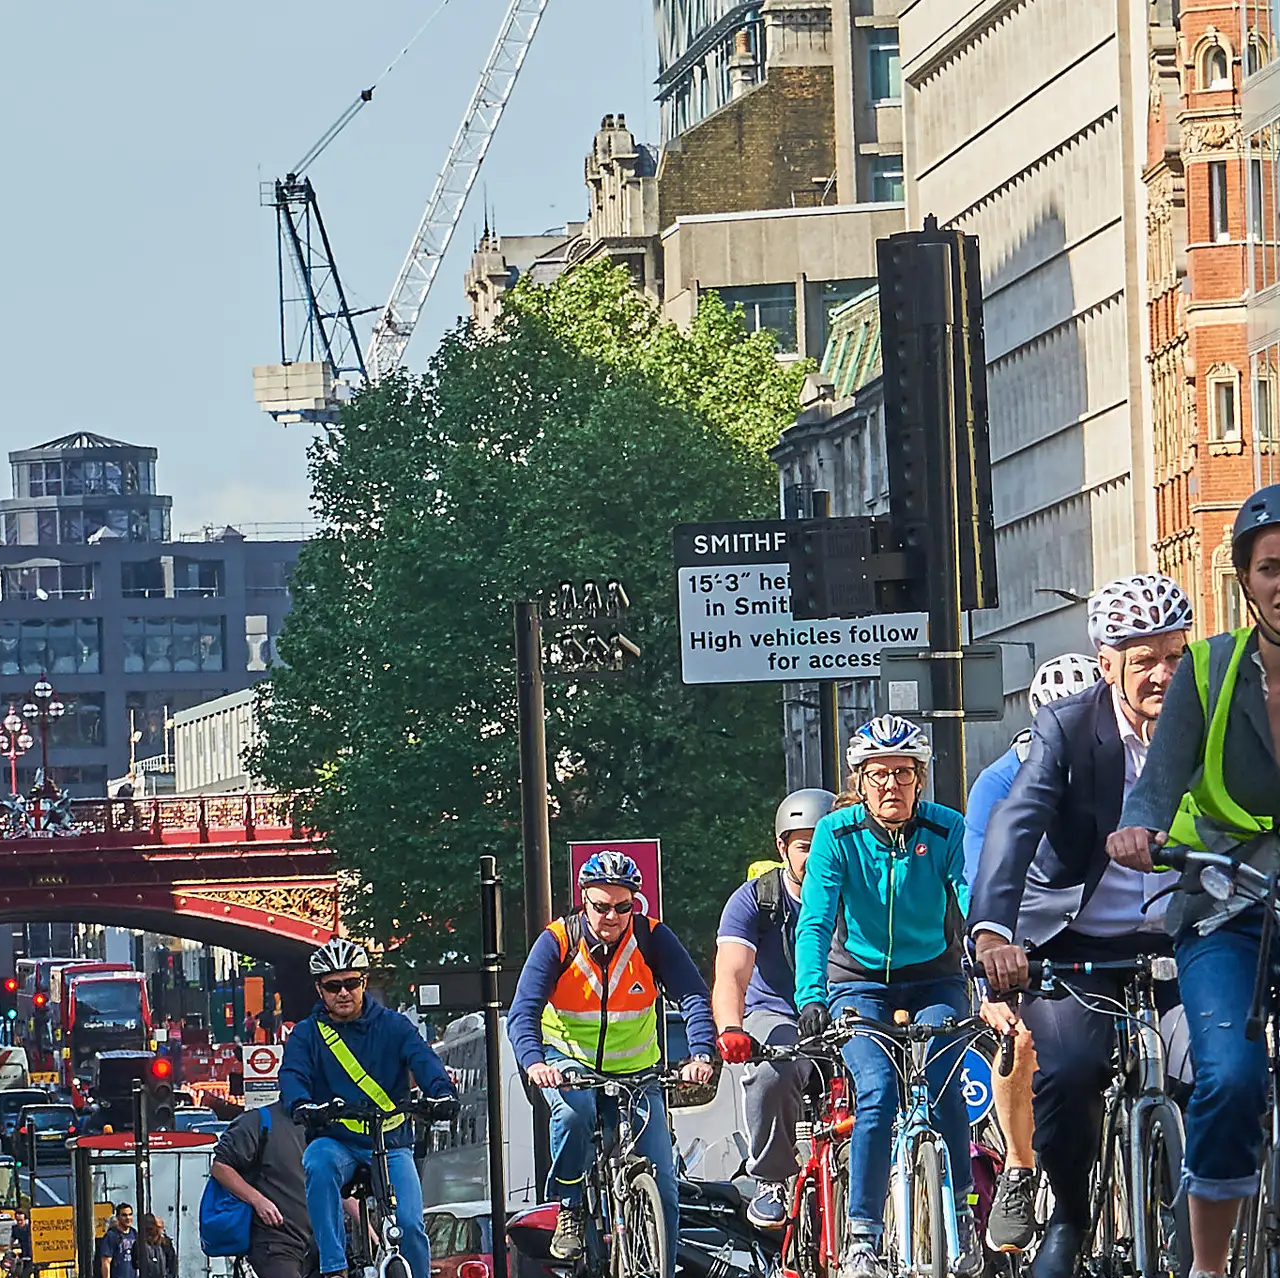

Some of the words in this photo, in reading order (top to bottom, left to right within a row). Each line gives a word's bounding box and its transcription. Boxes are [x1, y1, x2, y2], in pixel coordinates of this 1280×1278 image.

[694, 532, 787, 554] SMITHF
[705, 598, 726, 617] in
[690, 630, 742, 653] High
[749, 627, 841, 647] vehicles
[848, 625, 919, 644] follow
[768, 652, 800, 671] for
[809, 652, 881, 669] access
[124, 1018, 137, 1030] 45
